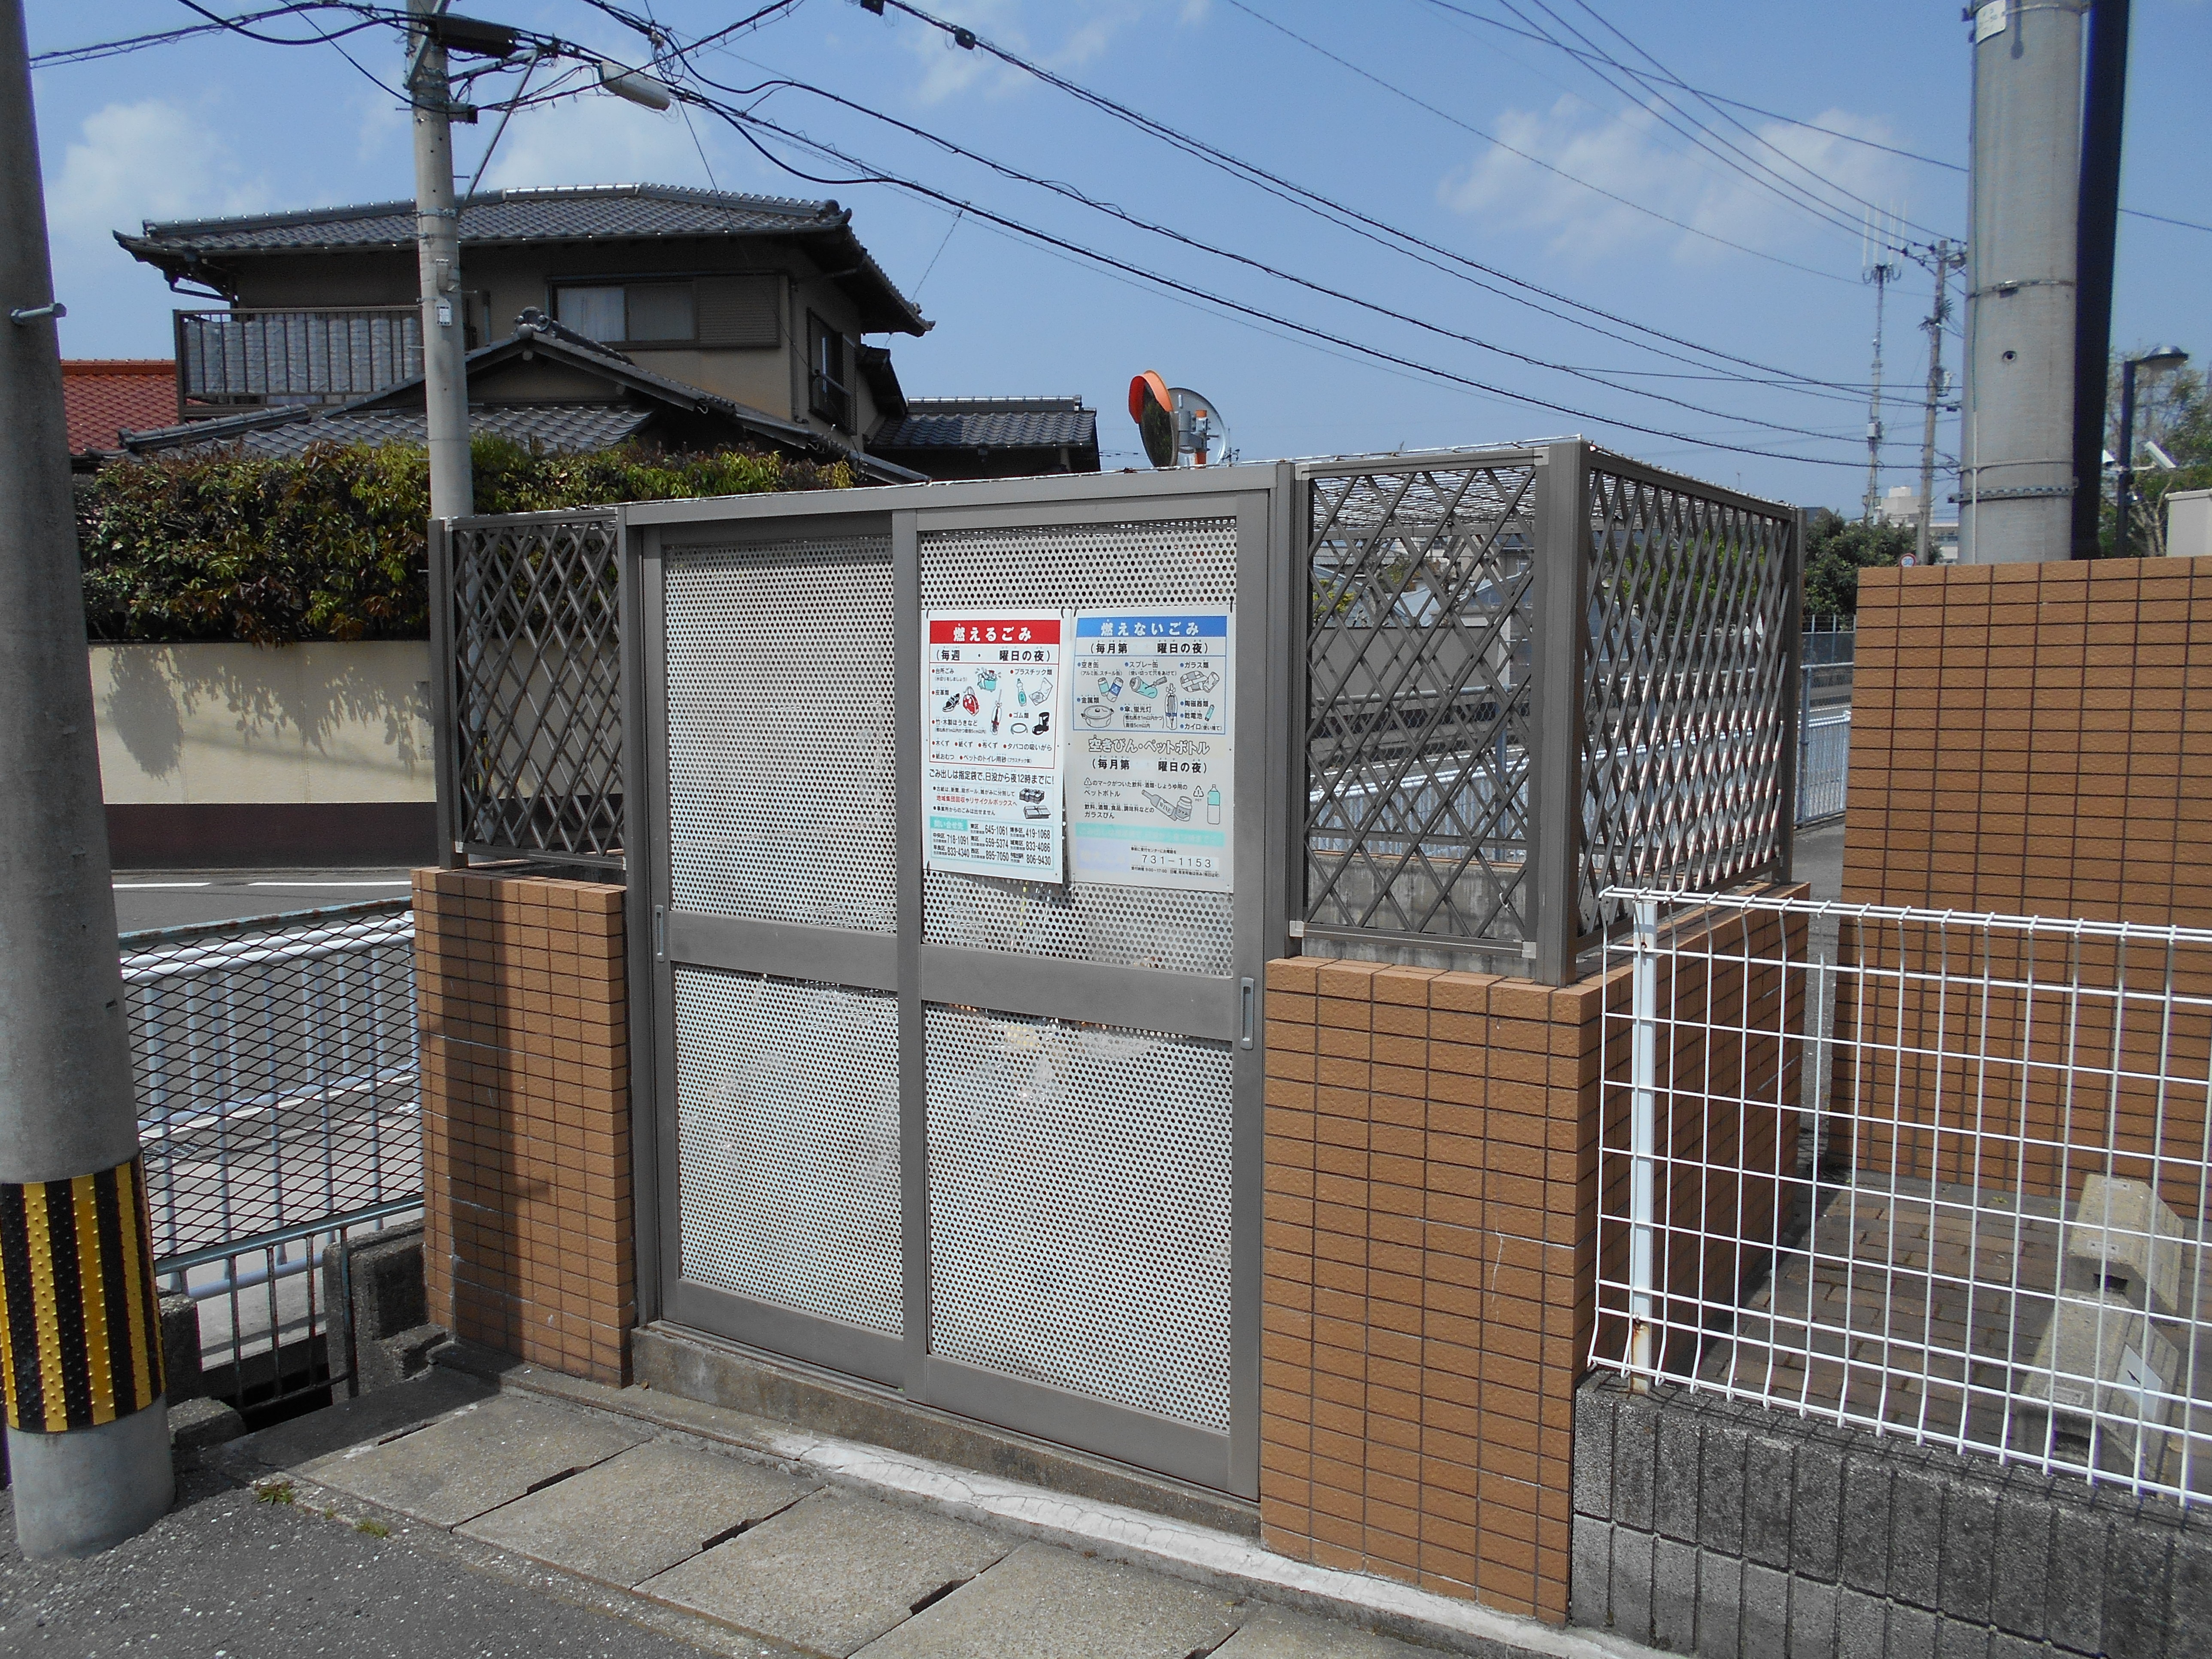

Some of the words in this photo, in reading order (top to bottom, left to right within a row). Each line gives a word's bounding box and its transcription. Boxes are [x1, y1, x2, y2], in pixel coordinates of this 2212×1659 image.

[953, 627, 1031, 642] 燃えるごみ
[1101, 622, 1199, 636] 燃えないごみ
[1091, 643, 1128, 654] (毎月第
[1157, 642, 1208, 654] 曜日の夜)
[936, 649, 960, 661] (毎週
[999, 650, 1050, 662] 曜日の夜)
[1008, 743, 1052, 751] タバコの吸いがら
[1088, 736, 1210, 755] 空きびん・ペットボトル
[1092, 758, 1130, 770] (毎月第
[1158, 761, 1206, 774] 曜日の夜)
[985, 824, 1008, 836] 645-1061
[1026, 828, 1050, 839] 419-1068
[947, 834, 969, 845] 718-1091
[985, 837, 1009, 848] 559-5374
[947, 846, 970, 858] 833-4340
[1026, 841, 1051, 852] 833-4086
[986, 850, 1009, 861] 895-7050
[1026, 854, 1051, 866] 806-9430
